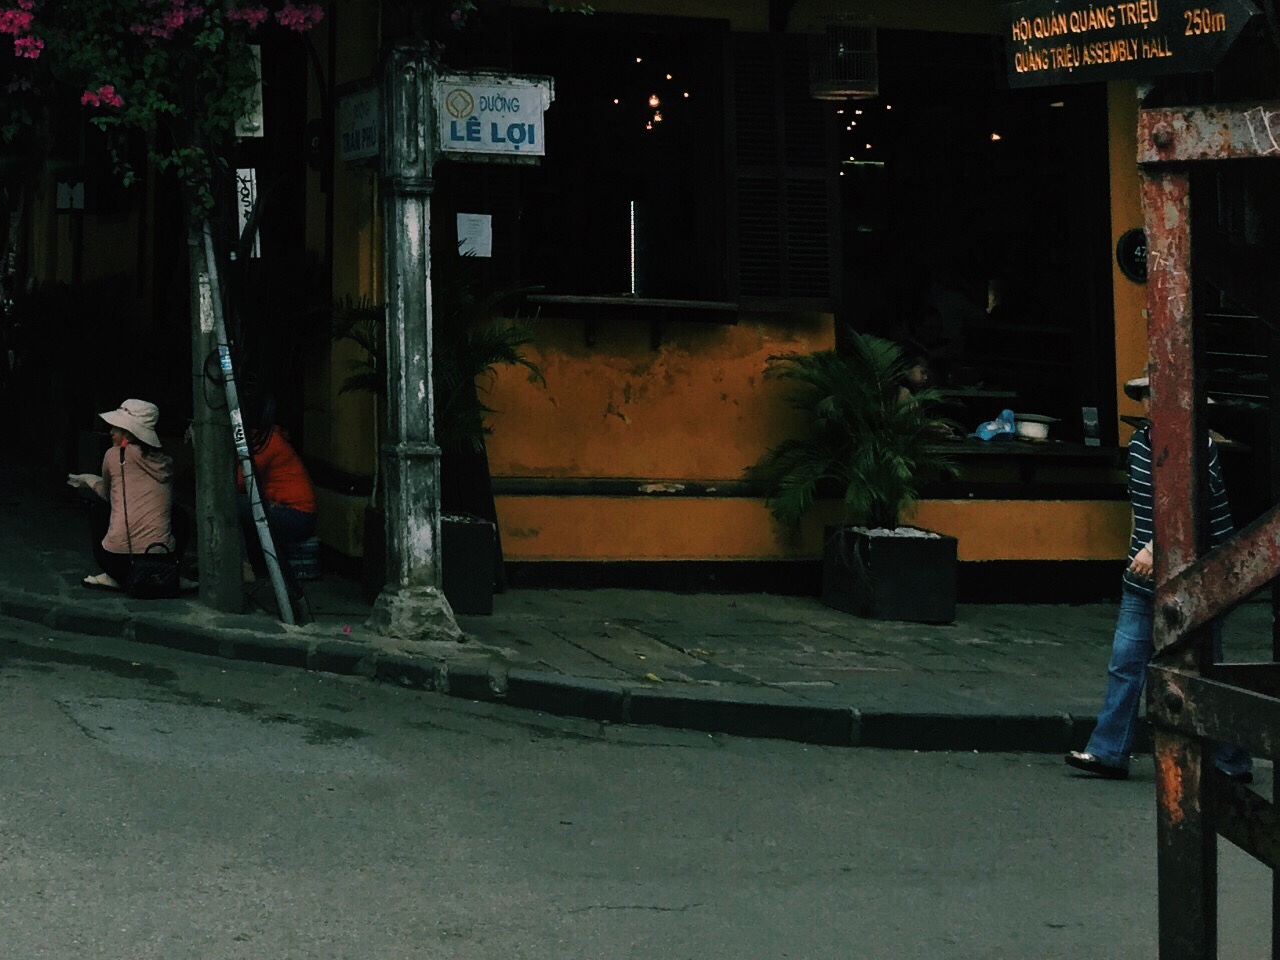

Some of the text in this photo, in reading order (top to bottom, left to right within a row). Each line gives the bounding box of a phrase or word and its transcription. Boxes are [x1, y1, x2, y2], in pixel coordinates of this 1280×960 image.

[1183, 7, 1226, 36] 250m
[1082, 37, 1139, 65] ASSEMBLY
[1142, 34, 1173, 59] HALL
[450, 115, 535, 150] LÊ LỢI
